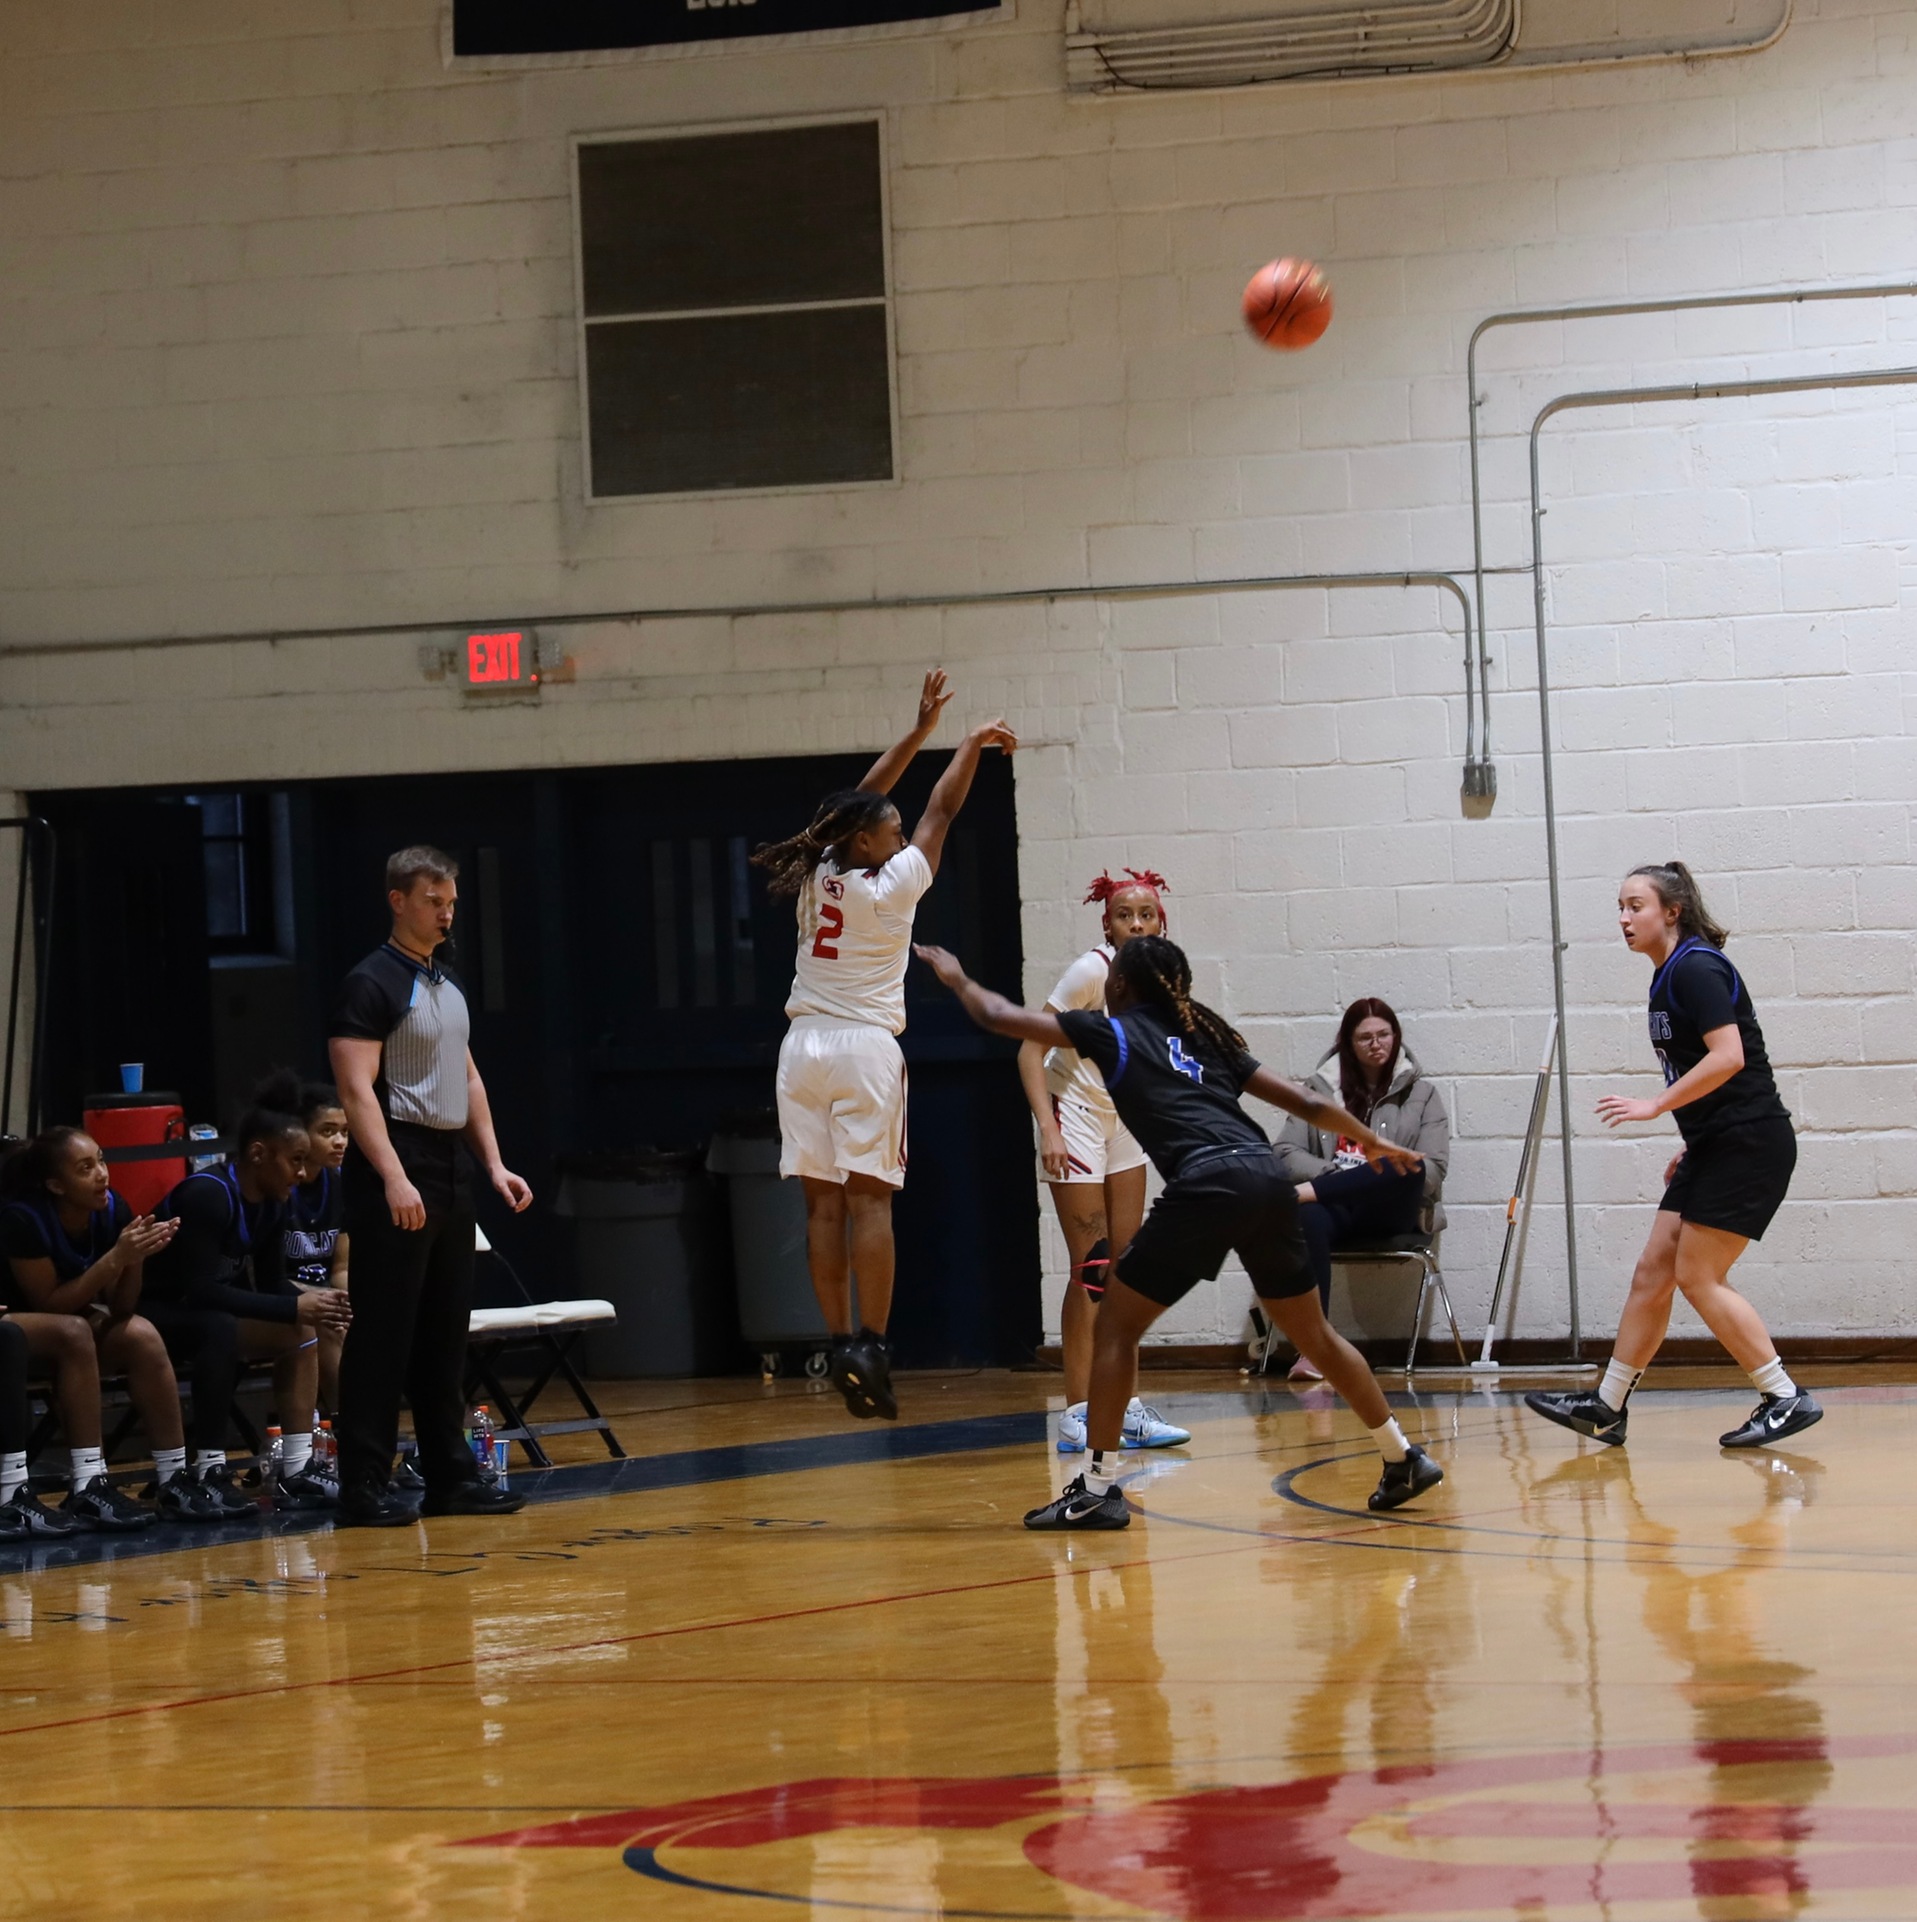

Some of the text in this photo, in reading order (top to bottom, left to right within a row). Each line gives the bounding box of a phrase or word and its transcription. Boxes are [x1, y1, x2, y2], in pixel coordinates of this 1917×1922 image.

[467, 632, 522, 683] EXIT
[812, 903, 843, 960] 2
[1167, 1036, 1204, 1084] 4
